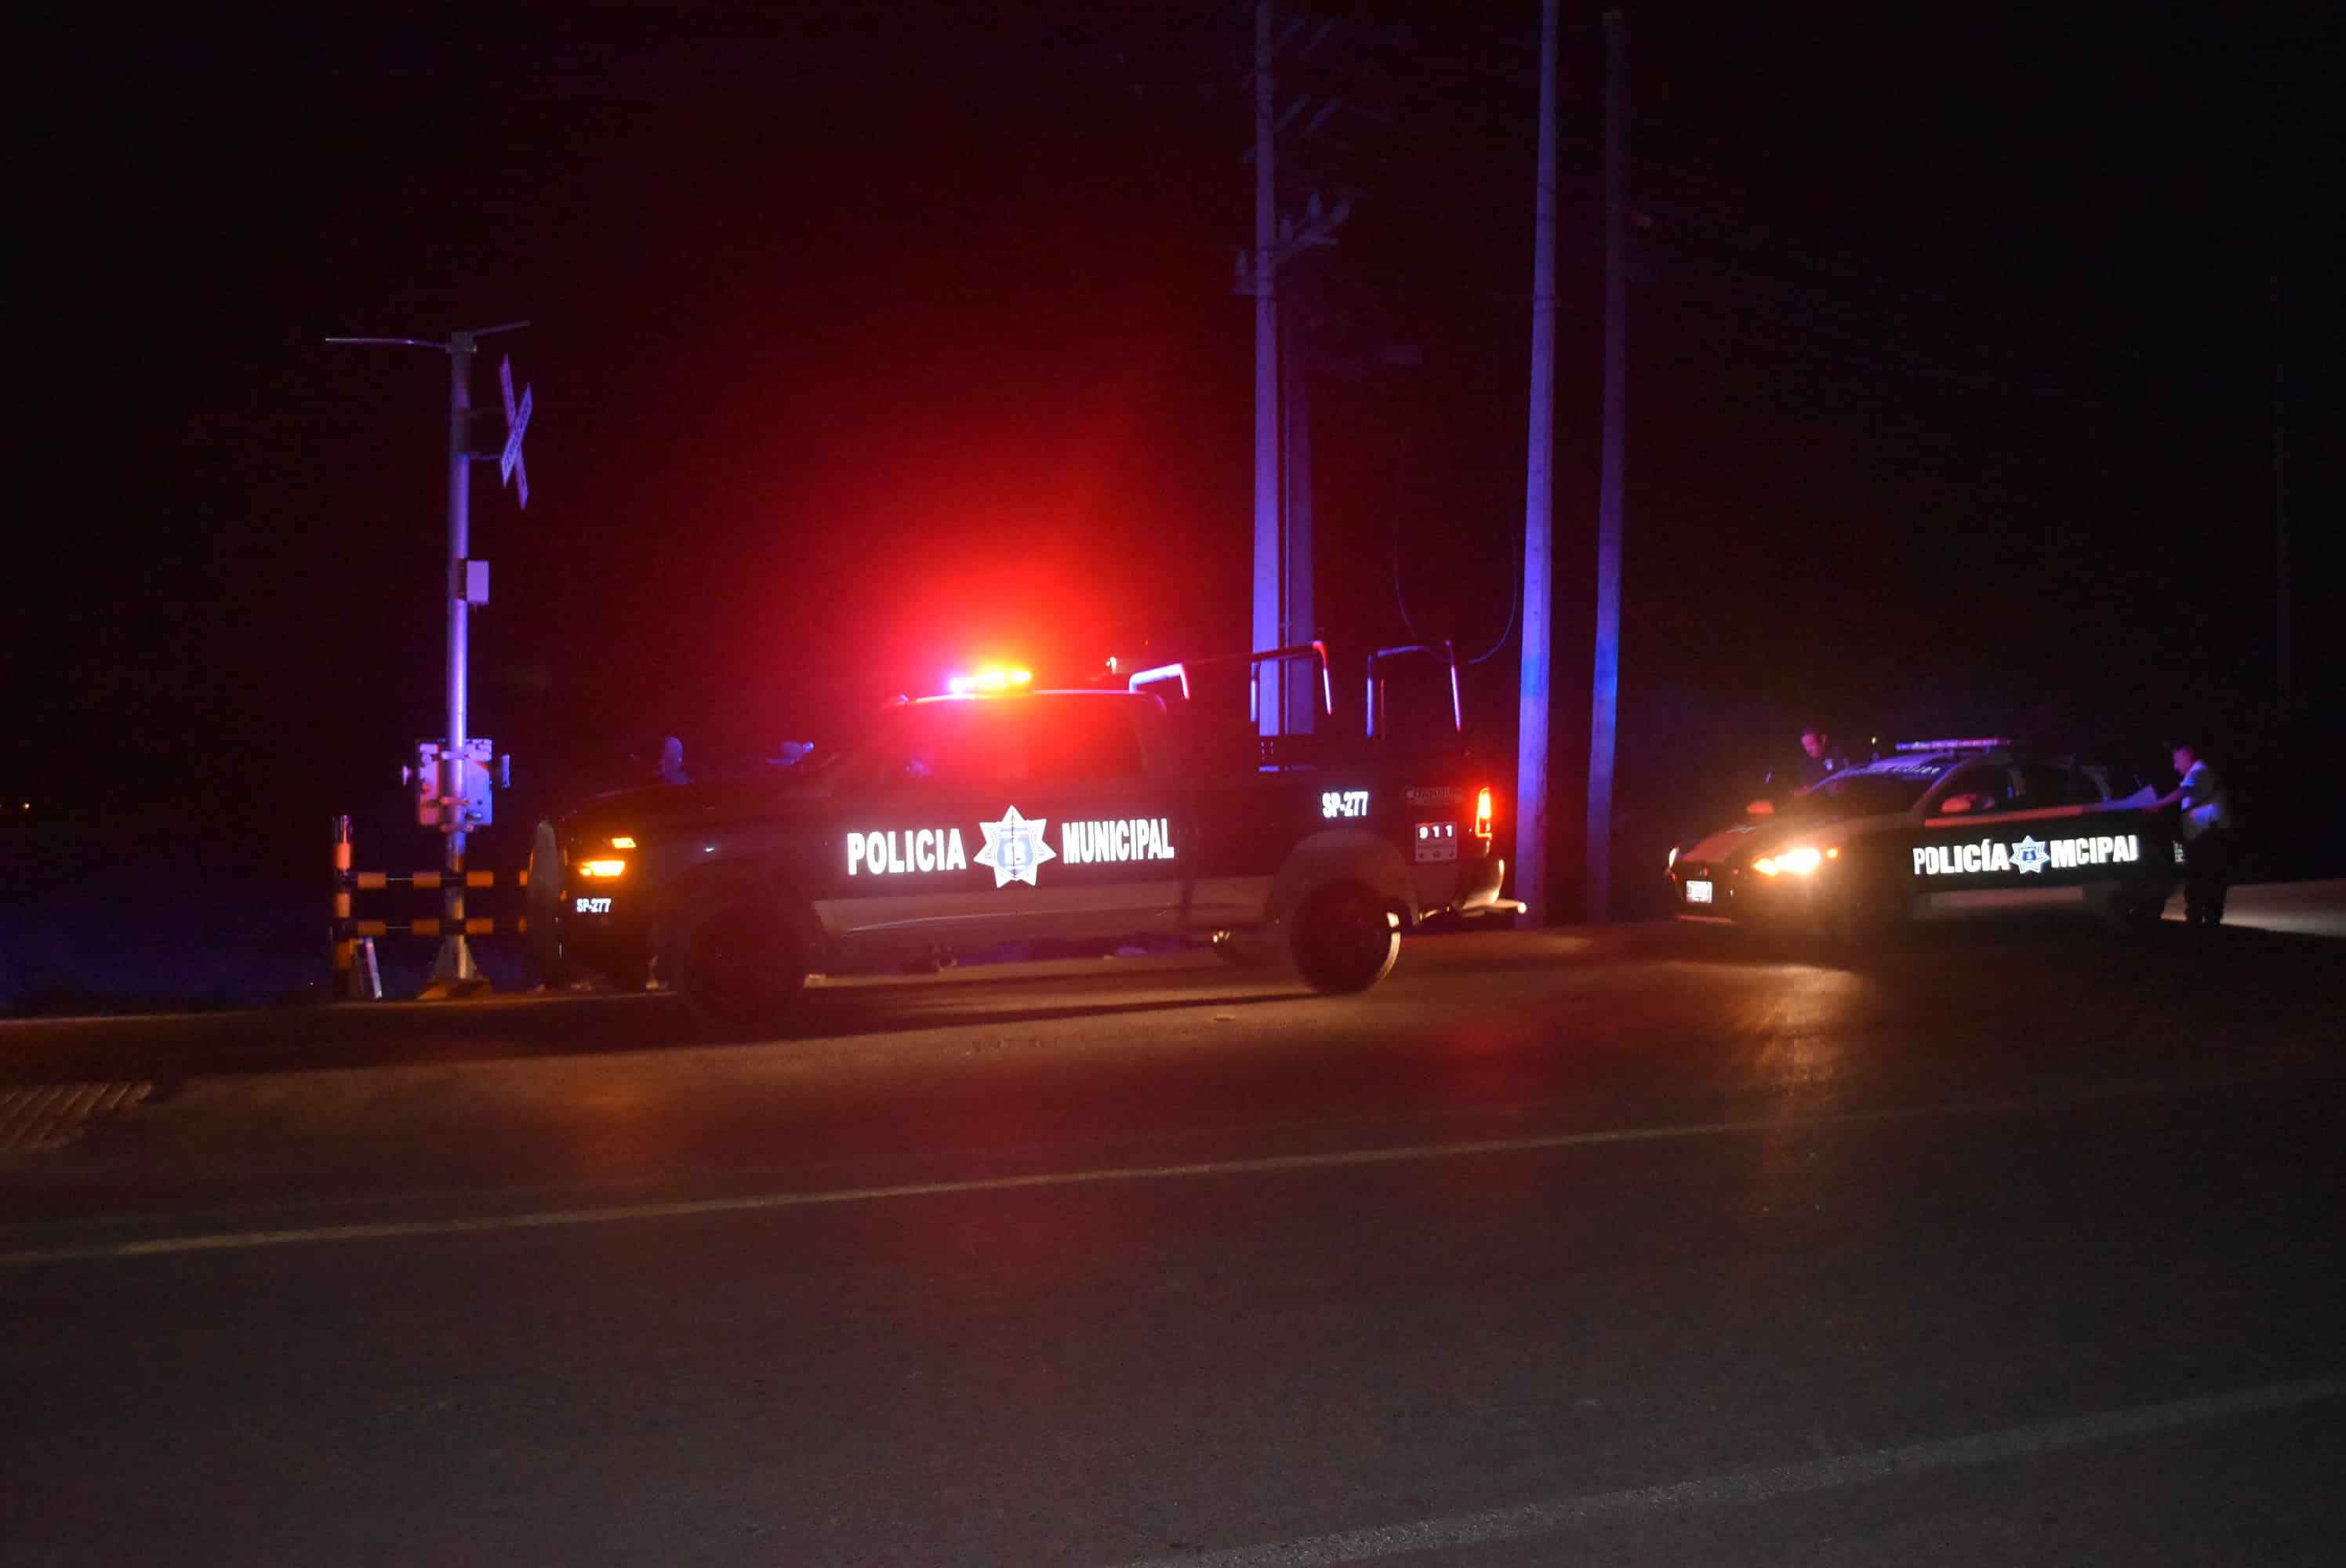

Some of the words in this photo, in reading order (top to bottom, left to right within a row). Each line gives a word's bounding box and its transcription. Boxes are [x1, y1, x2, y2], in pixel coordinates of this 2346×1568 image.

[1322, 790, 1369, 818] SP-277
[846, 827, 968, 876] POLICIA
[1061, 818, 1175, 865] MUNICIPAL
[1912, 838, 2011, 876] POLICÍA
[576, 898, 612, 913] SP-277
